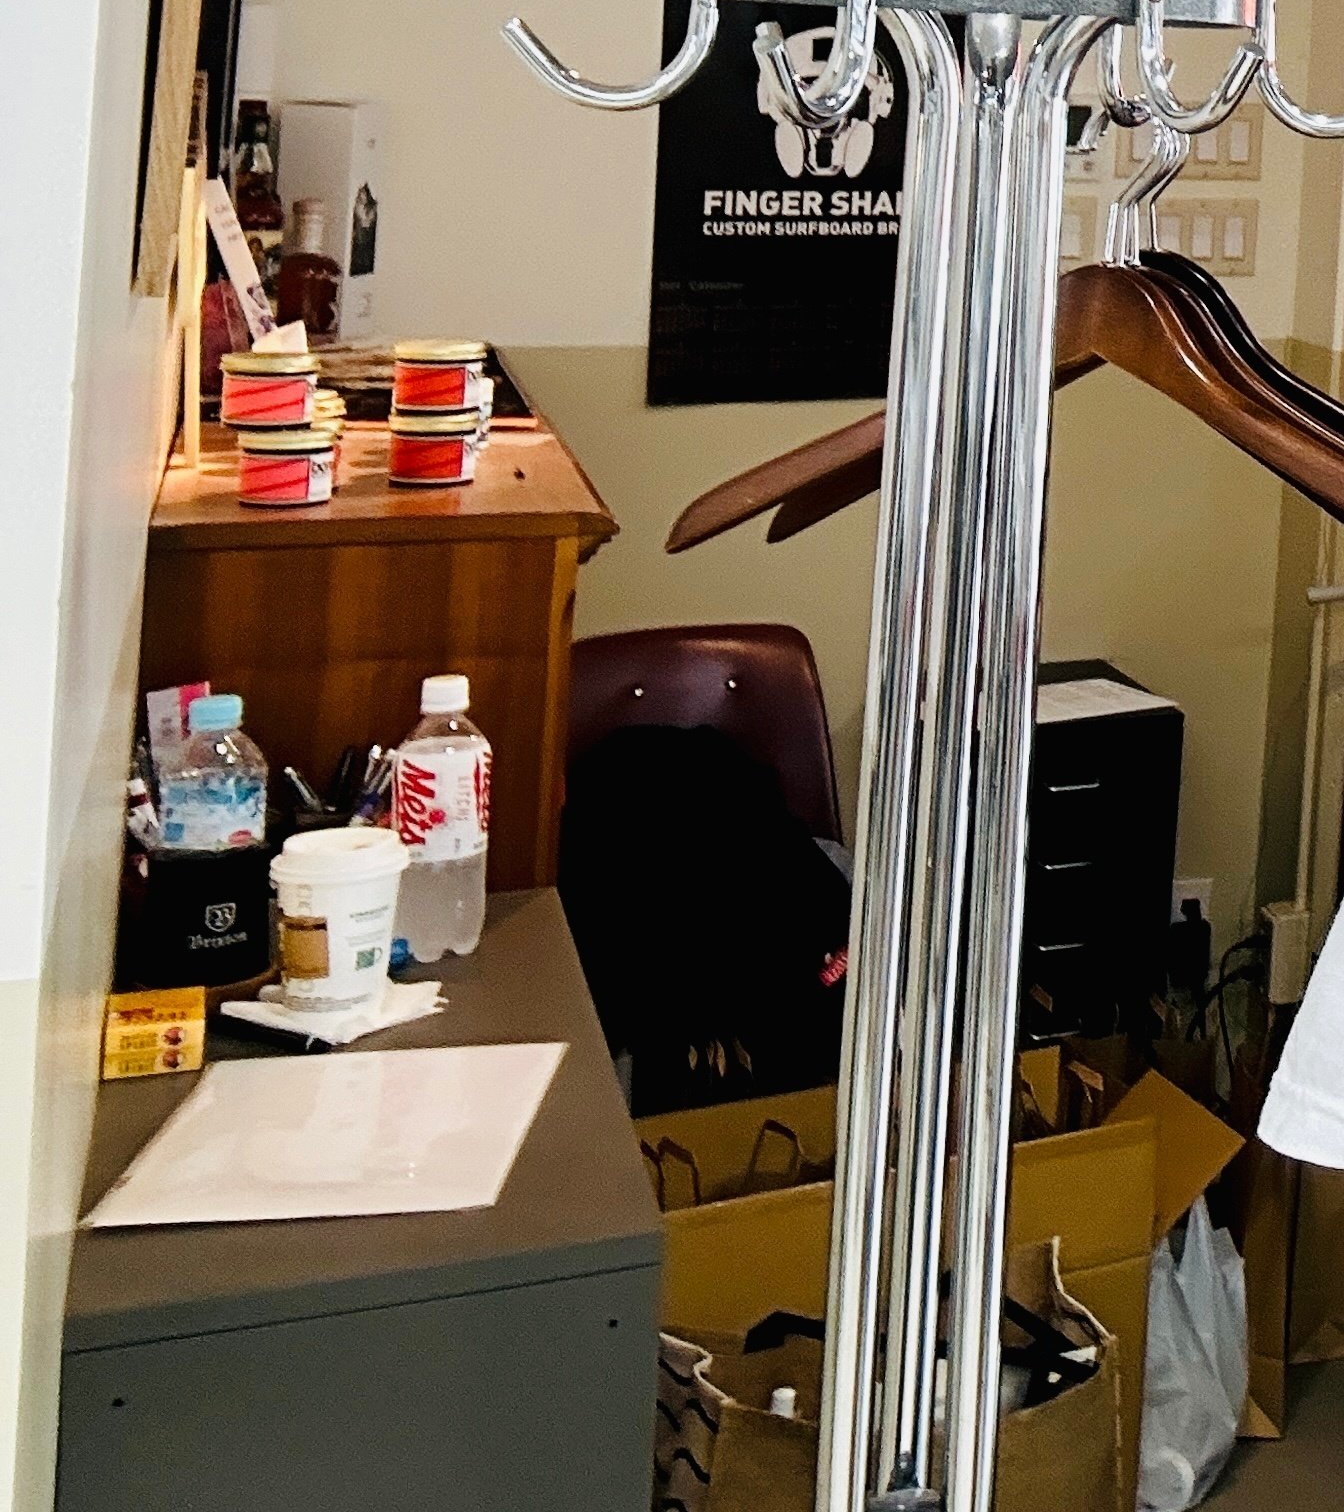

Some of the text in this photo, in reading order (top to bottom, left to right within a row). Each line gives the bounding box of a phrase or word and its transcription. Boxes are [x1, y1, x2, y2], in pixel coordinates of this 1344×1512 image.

[703, 190, 902, 217] FINGER SHA
[702, 221, 900, 236] CUSTOM SURFBOARD BR
[400, 759, 436, 846] Mets
